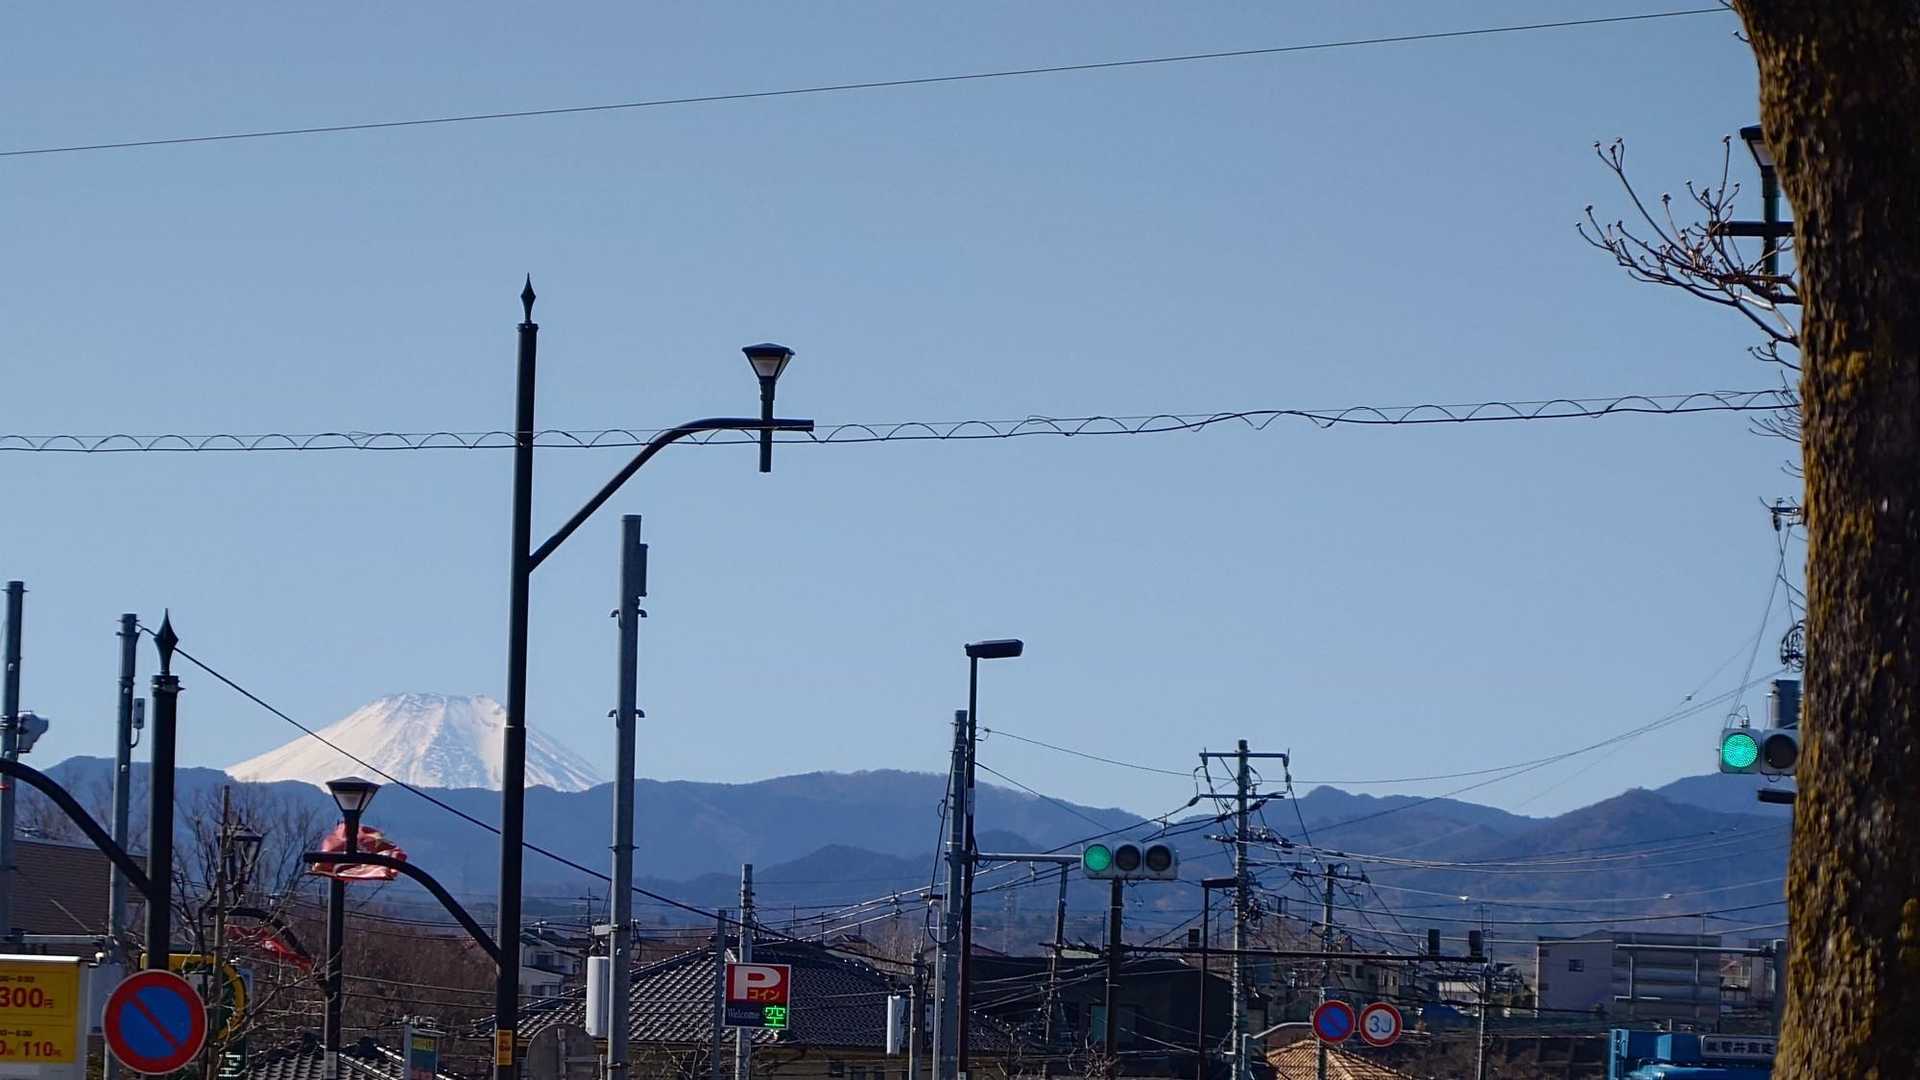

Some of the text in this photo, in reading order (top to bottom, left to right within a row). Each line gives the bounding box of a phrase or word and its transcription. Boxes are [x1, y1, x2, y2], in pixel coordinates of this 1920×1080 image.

[733, 965, 781, 1000] P
[749, 989, 780, 1000] コイン
[763, 1004, 787, 1027] 空
